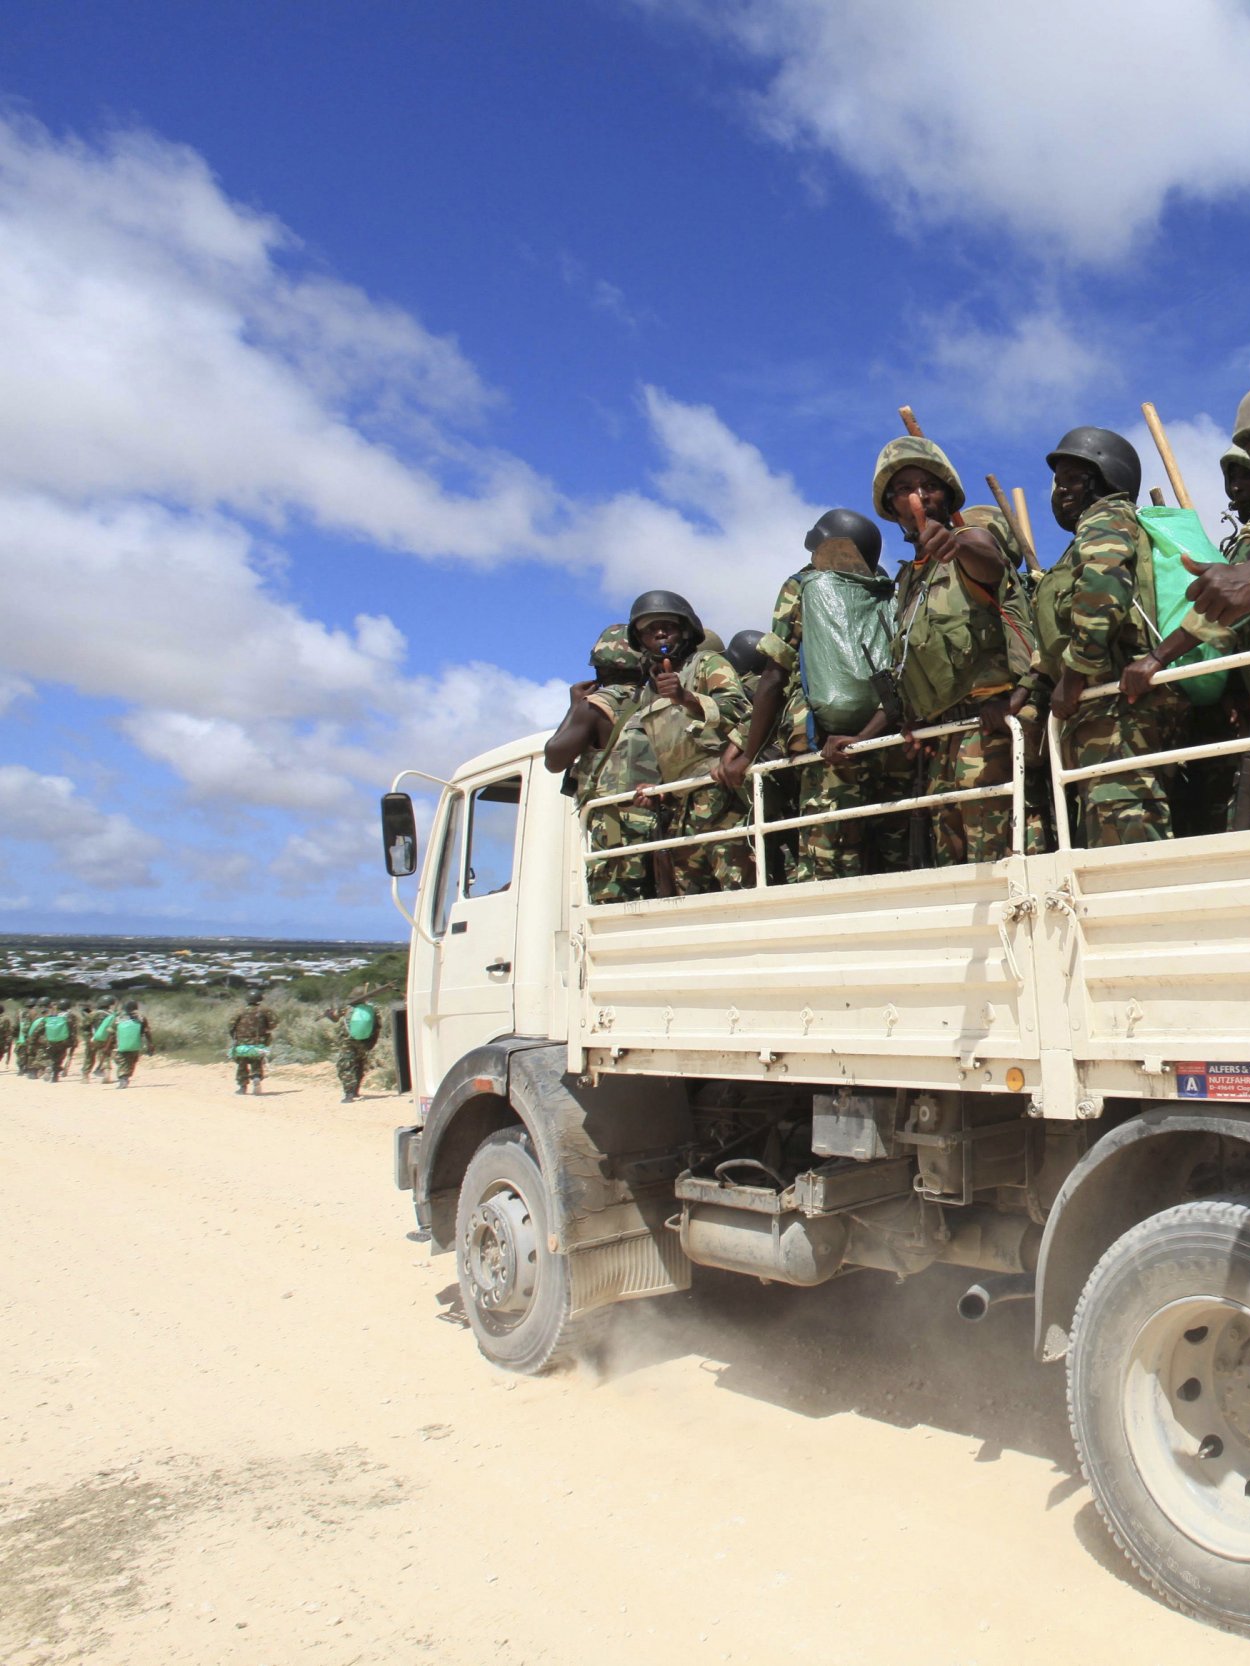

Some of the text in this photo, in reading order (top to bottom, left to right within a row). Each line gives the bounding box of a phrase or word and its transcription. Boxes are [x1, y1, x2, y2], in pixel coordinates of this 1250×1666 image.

[1209, 1065, 1240, 1074] ALFERS
[1241, 1065, 1249, 1074] &
[1186, 1077, 1198, 1091] A
